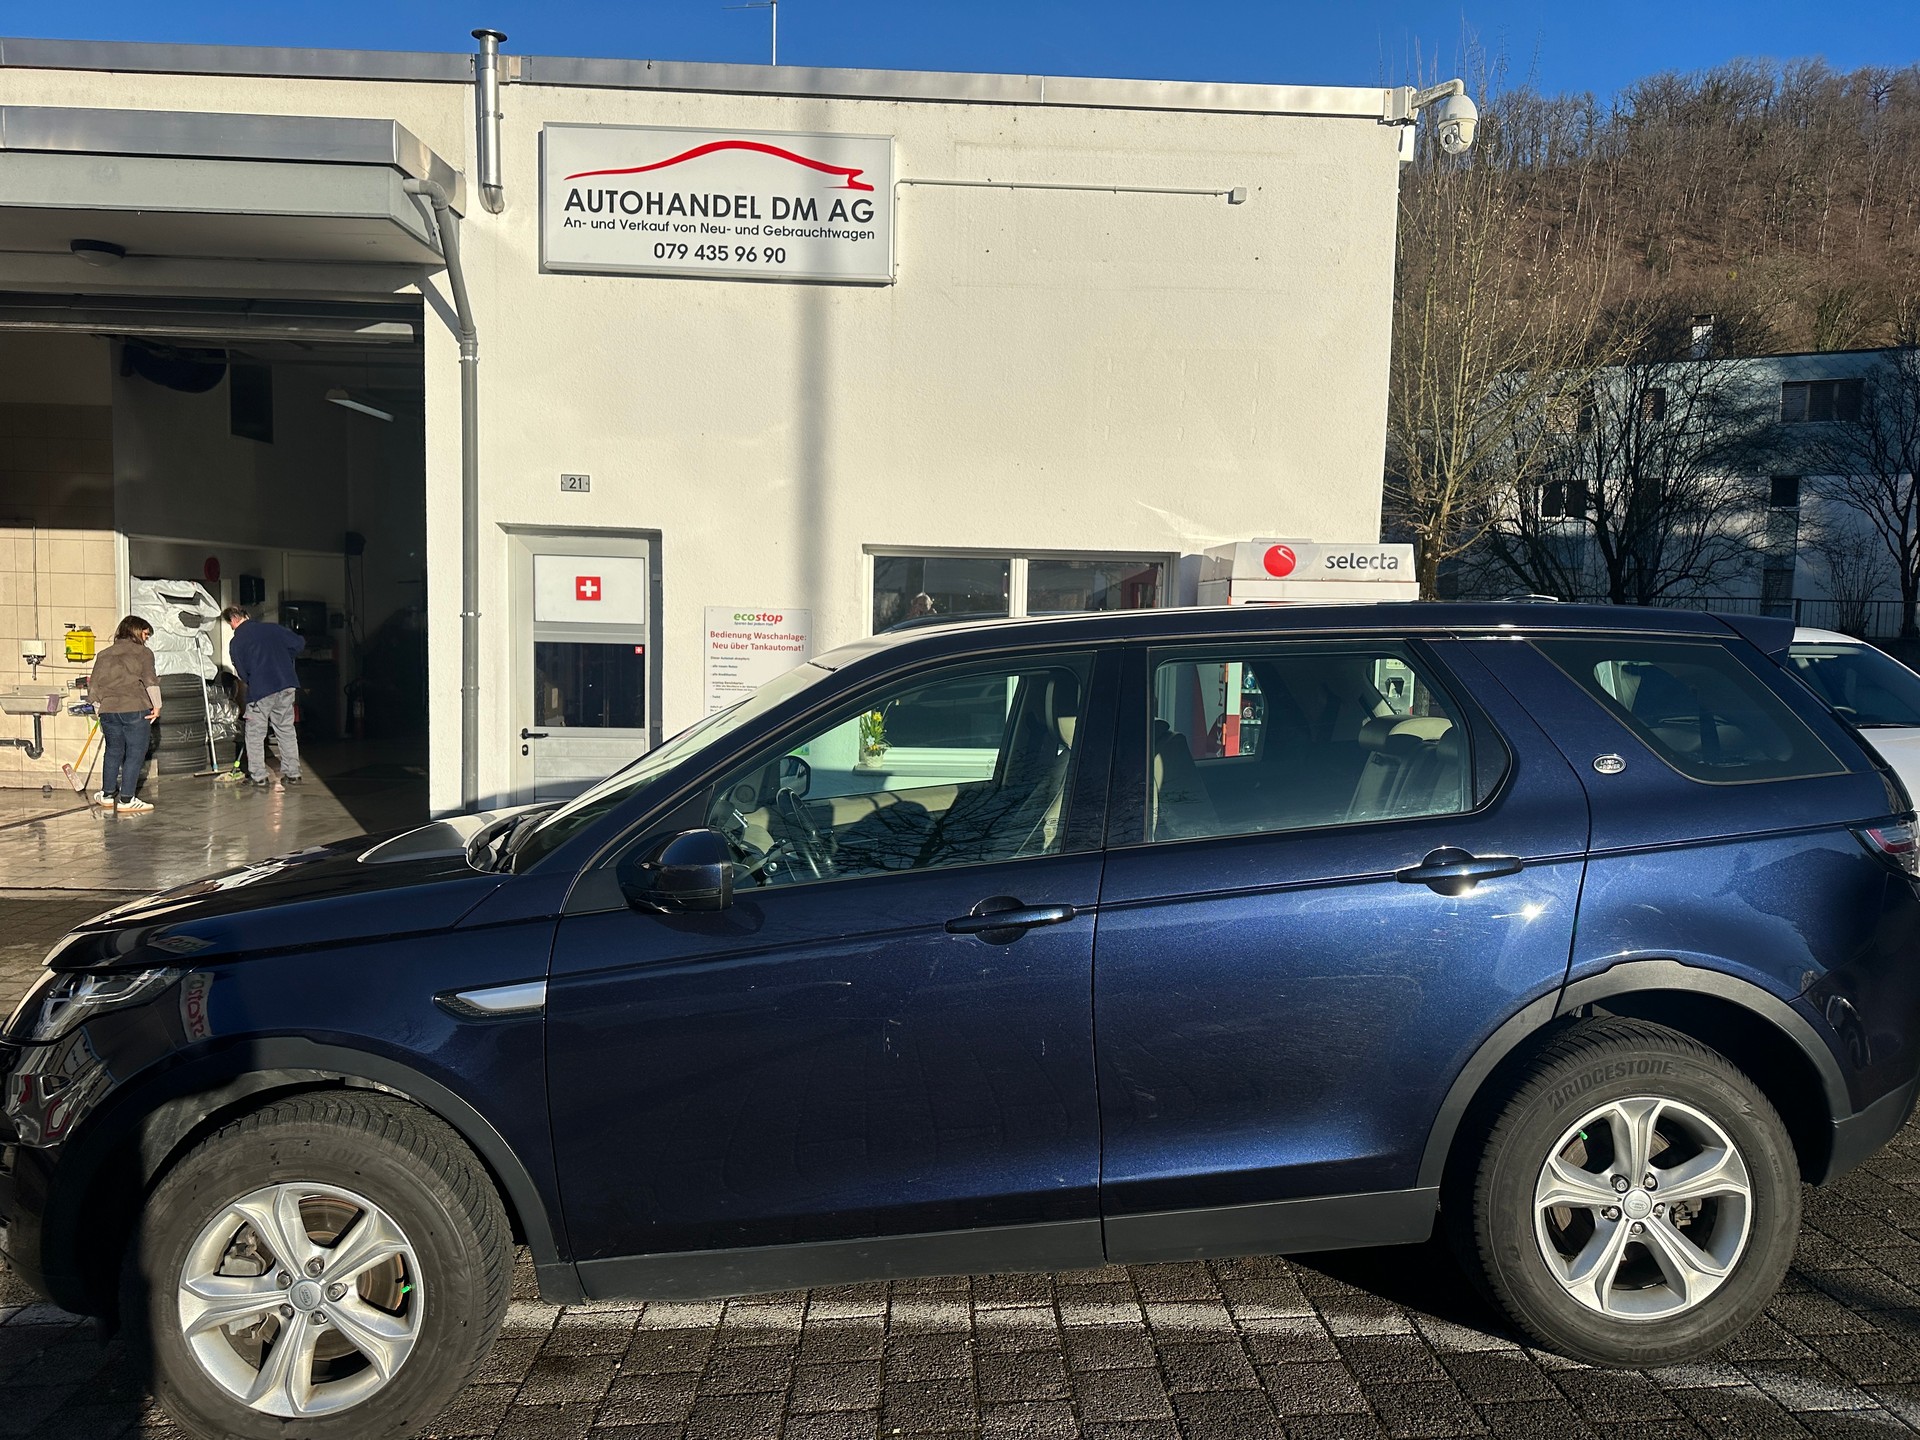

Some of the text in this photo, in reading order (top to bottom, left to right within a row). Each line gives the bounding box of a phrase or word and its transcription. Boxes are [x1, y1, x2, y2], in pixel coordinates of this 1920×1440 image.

[564, 188, 874, 223] AUTOHANDEL DM AG
[563, 217, 875, 242] An- und Verkauf von Neu- und Gebrauchtwagen
[654, 242, 786, 263] 079 435 96 90
[569, 477, 582, 489] 21
[1325, 553, 1399, 570] selecta
[733, 612, 783, 624] ecostop
[710, 631, 807, 642] Bedienung Waschanlage:
[712, 641, 805, 652] Neu über Tankautomat!
[1547, 1060, 1673, 1113] BRIDGESTONE
